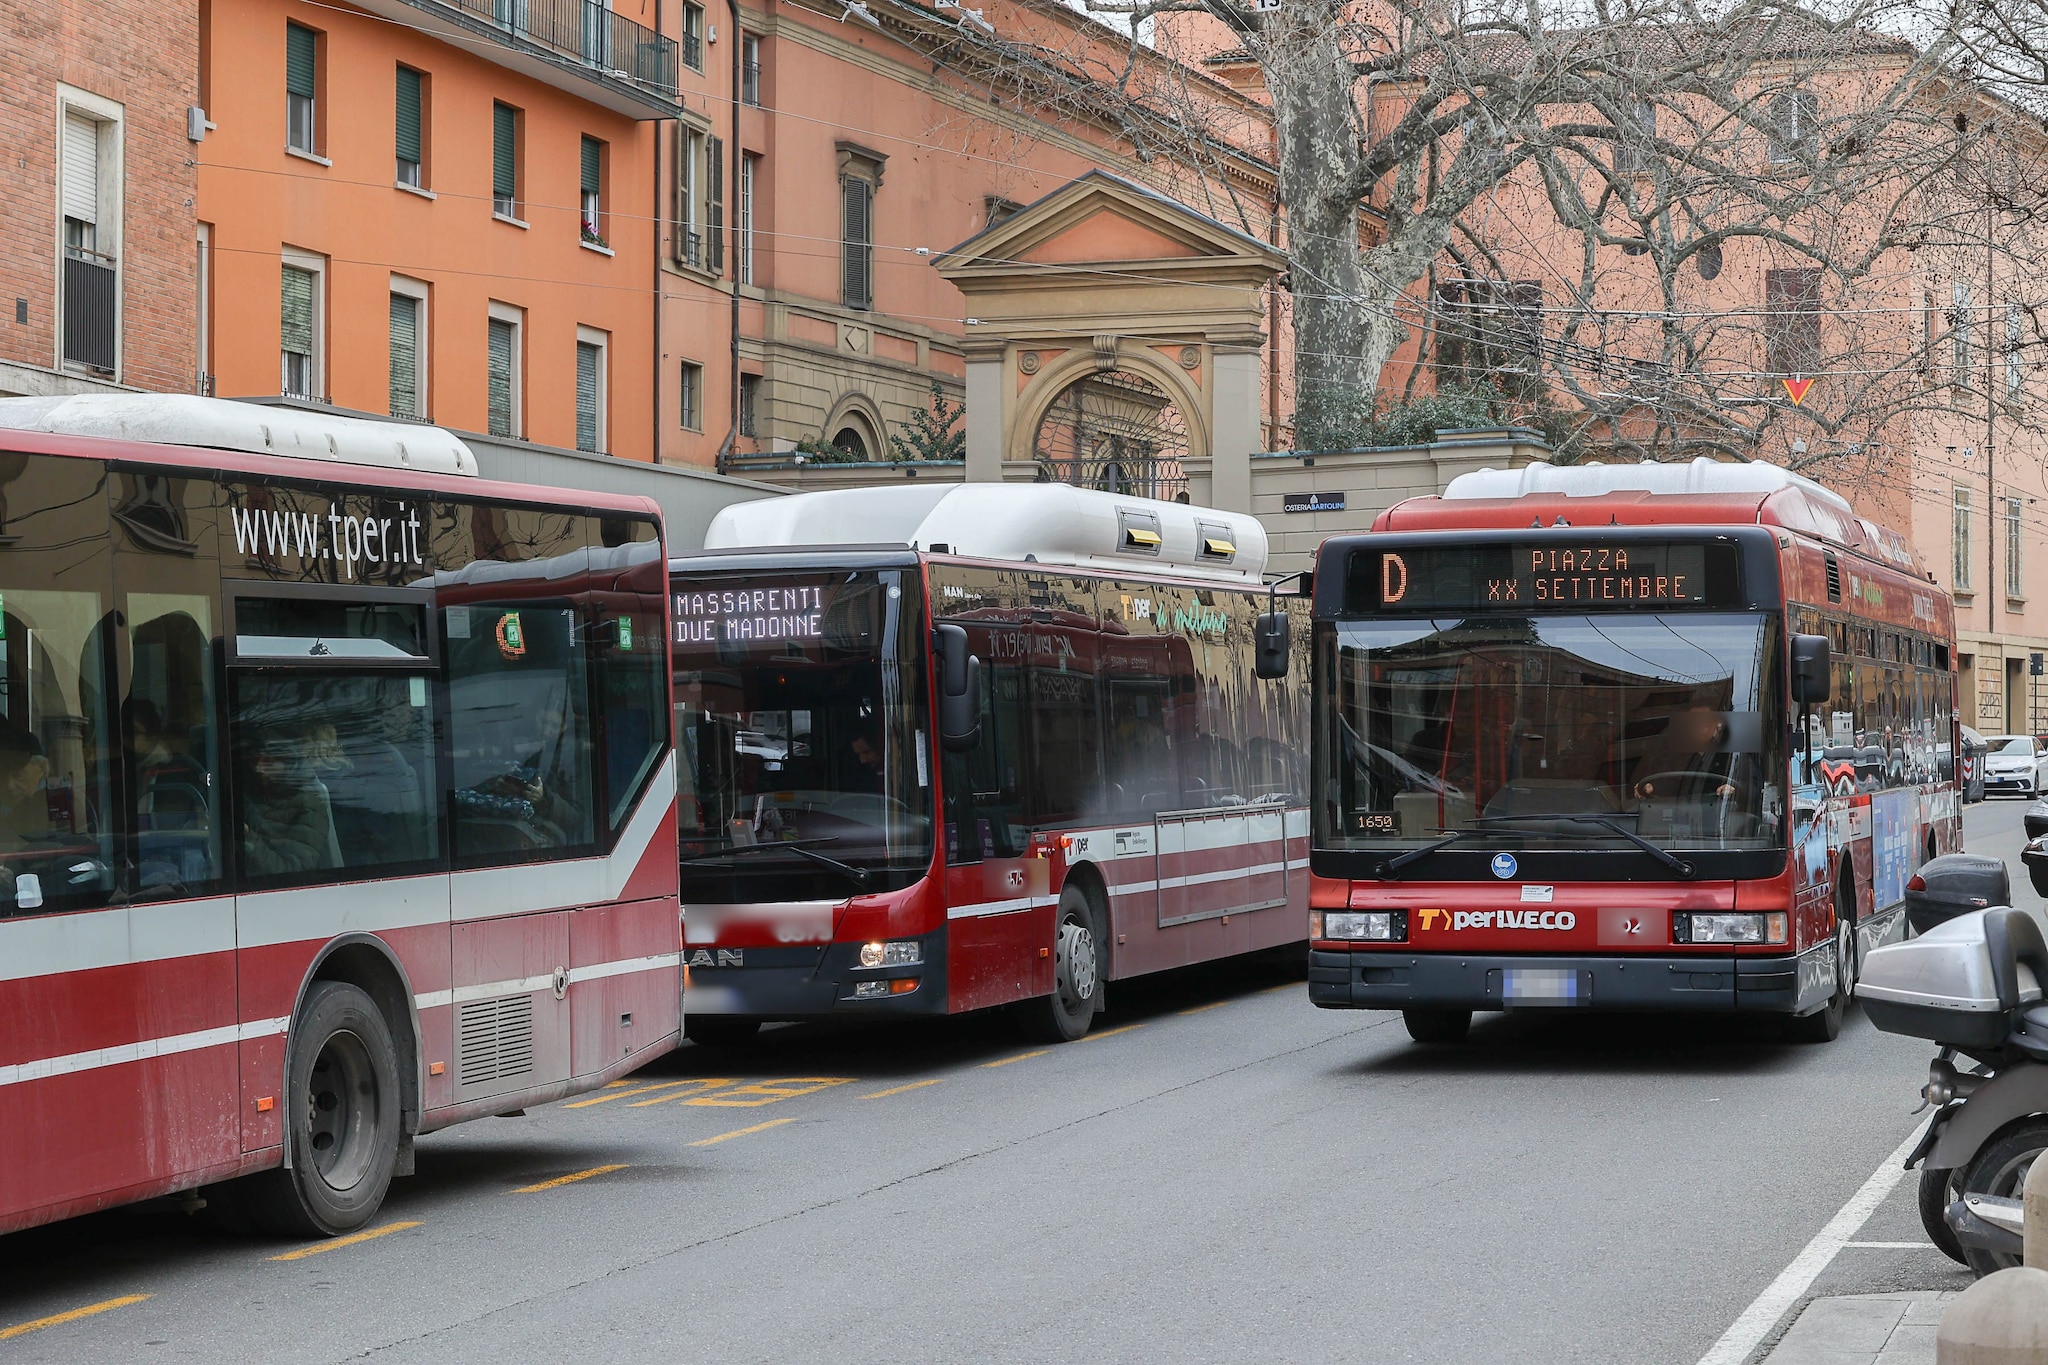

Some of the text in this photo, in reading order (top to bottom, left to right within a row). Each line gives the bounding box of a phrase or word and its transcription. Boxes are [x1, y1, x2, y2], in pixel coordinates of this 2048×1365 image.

[231, 501, 422, 579] www.tper.it
[1532, 549, 1628, 572] PIAZZA
[1382, 553, 1407, 602] D
[1536, 576, 1686, 600] SETTEMBRE
[677, 587, 821, 615] MASSARENTI
[943, 585, 964, 598] MAN
[677, 614, 821, 641] DUE MADONNE
[1497, 910, 1576, 931] IVECO
[689, 948, 744, 967] AN
